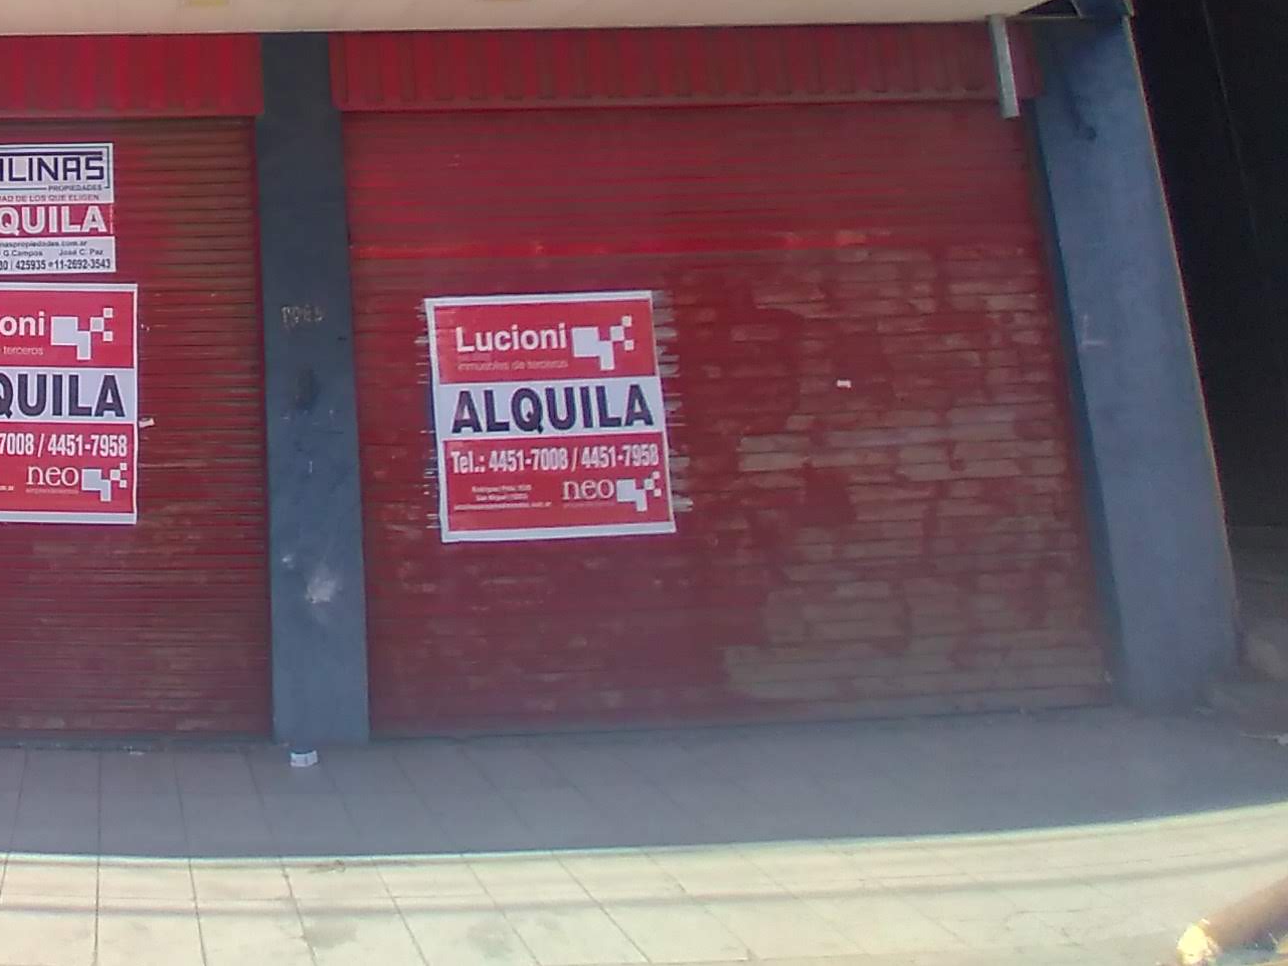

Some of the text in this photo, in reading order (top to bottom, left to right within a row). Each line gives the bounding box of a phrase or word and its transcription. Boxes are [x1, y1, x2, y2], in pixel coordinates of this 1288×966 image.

[455, 322, 568, 353] Lucioni
[451, 384, 655, 434] ALQUILA
[47, 433, 128, 457] 4451-7958
[450, 450, 485, 474] Tel.:
[25, 465, 80, 487] neo
[562, 478, 616, 501] neo
